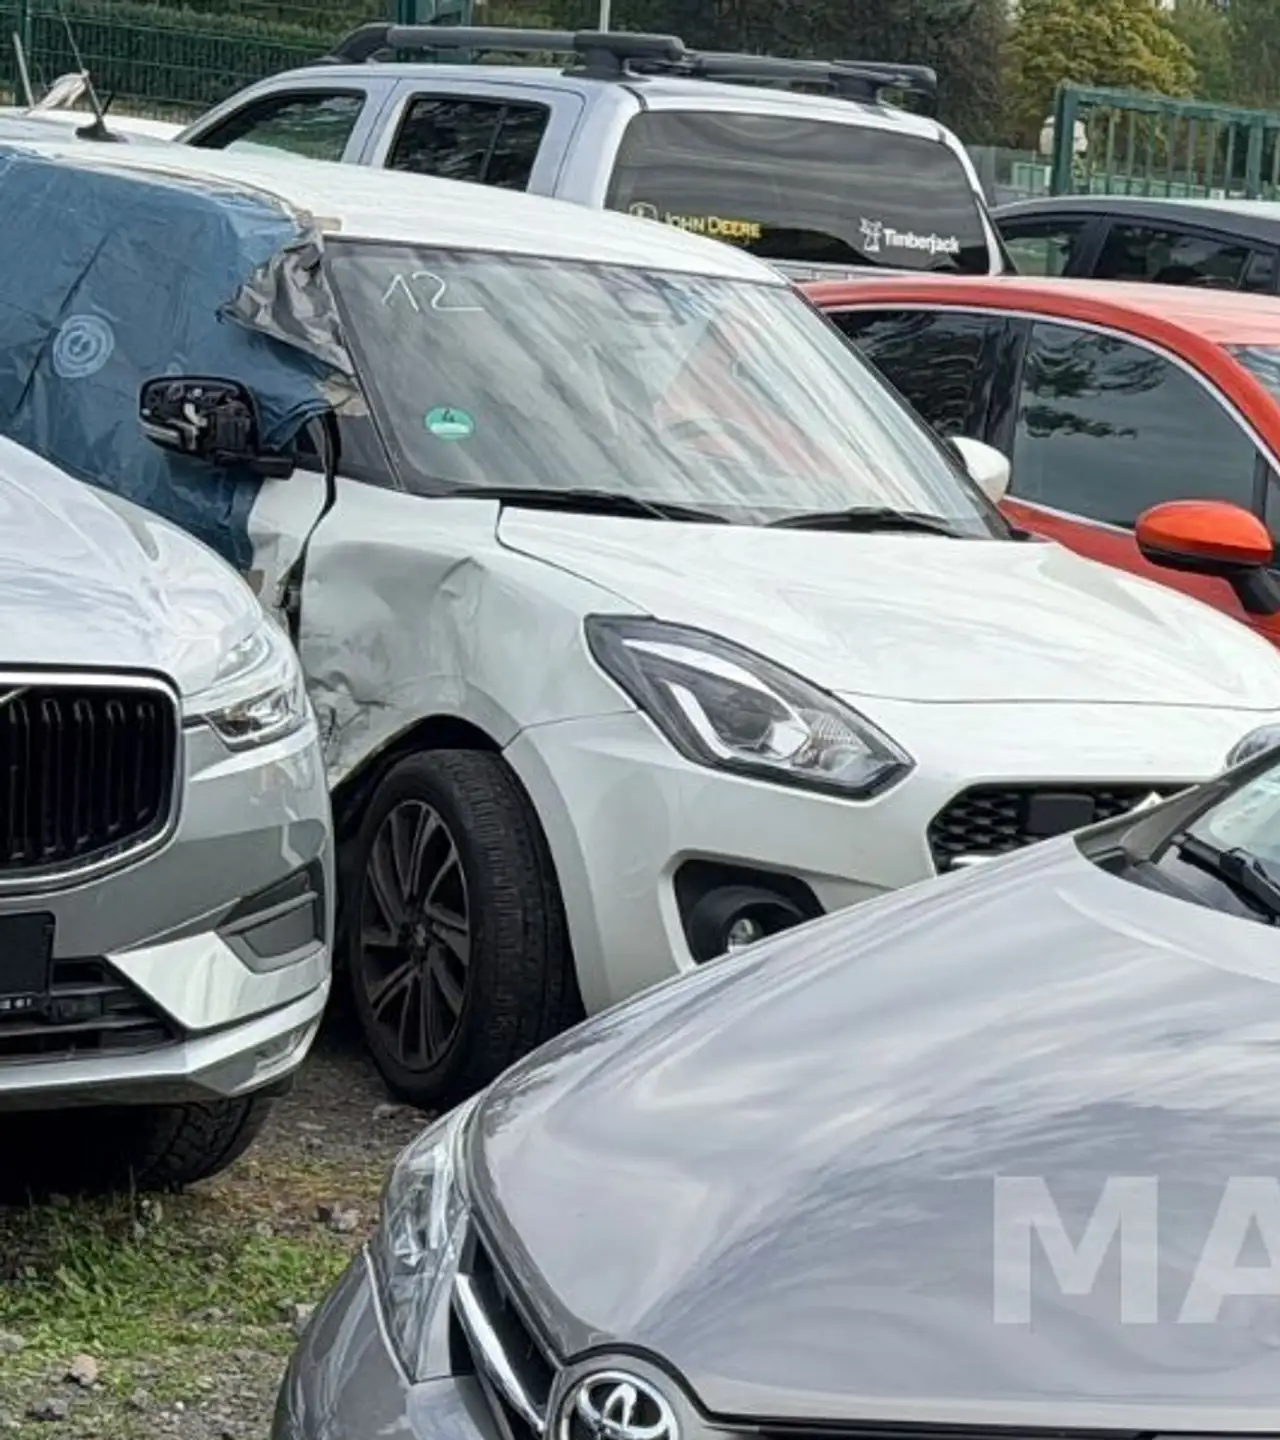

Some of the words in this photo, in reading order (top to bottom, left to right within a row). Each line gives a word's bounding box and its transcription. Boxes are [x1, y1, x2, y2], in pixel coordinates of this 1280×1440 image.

[664, 212, 705, 232] JOHN
[707, 216, 761, 239] DEERE
[883, 228, 960, 254] Timberjack
[381, 270, 485, 313] 12
